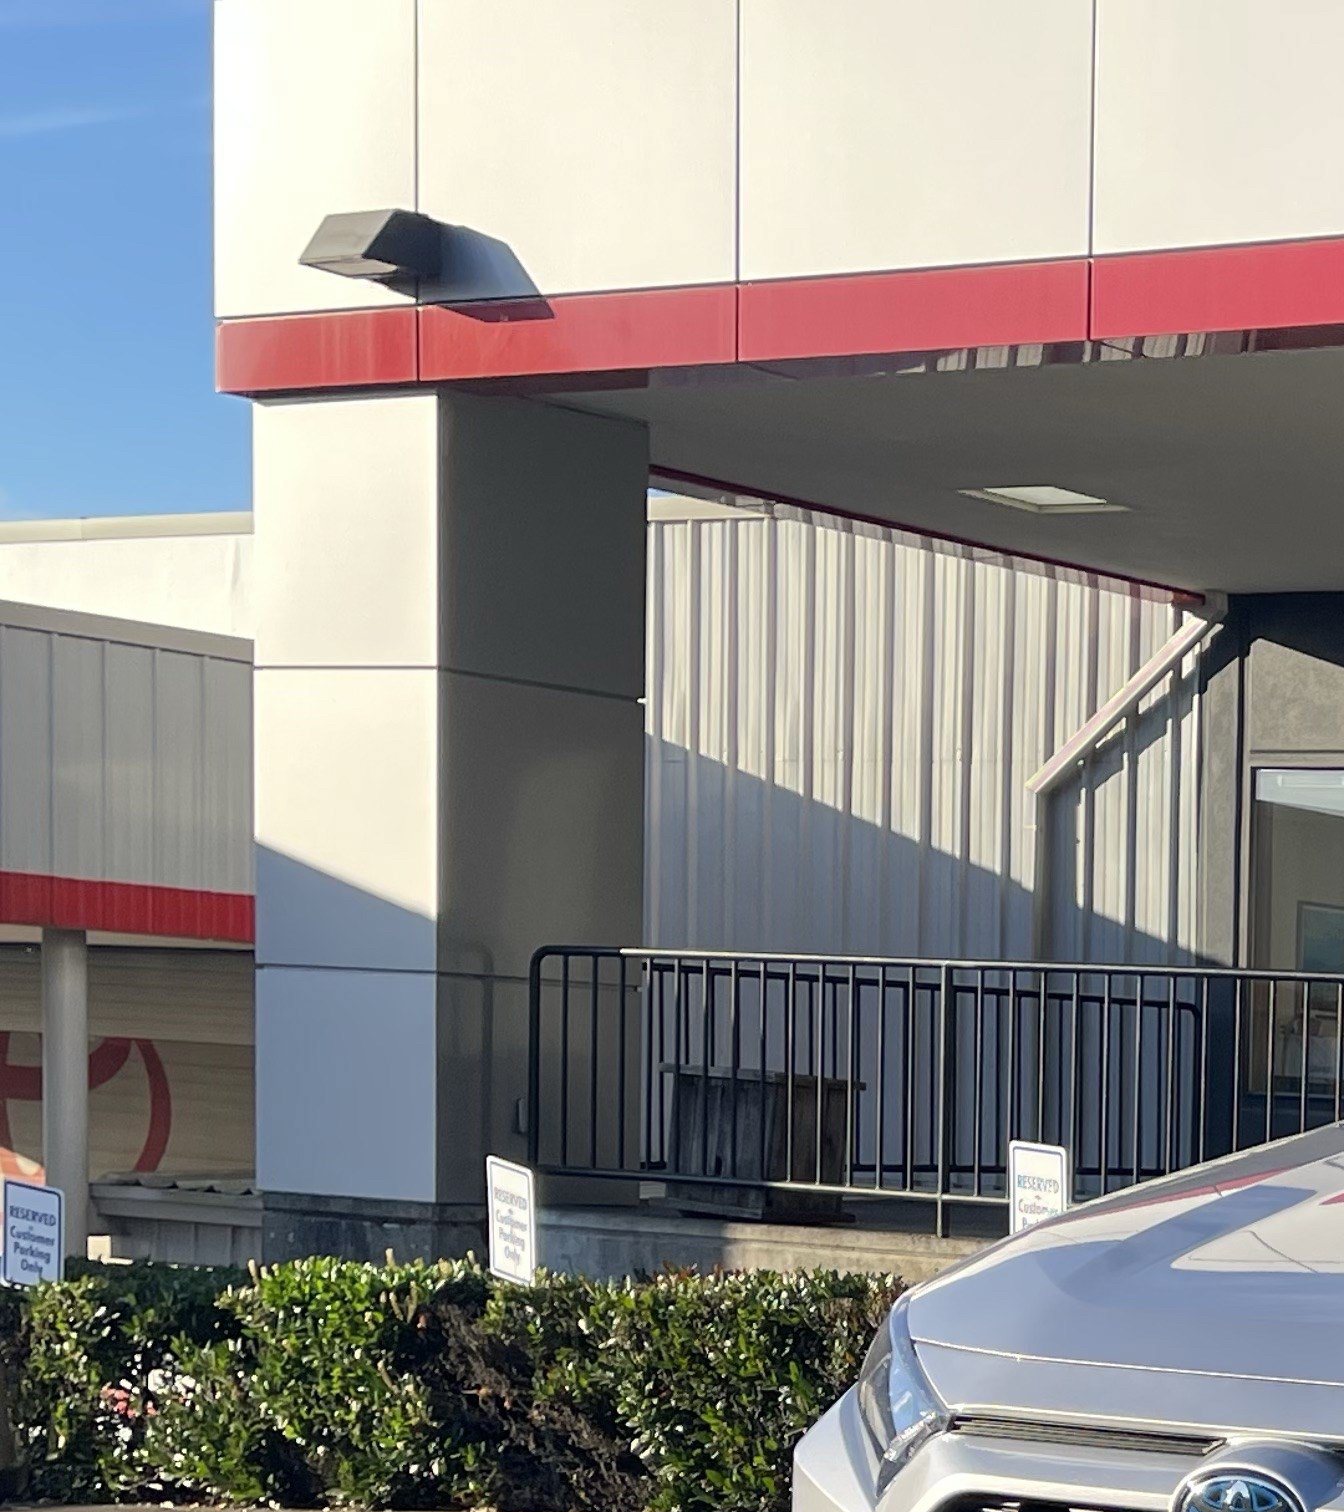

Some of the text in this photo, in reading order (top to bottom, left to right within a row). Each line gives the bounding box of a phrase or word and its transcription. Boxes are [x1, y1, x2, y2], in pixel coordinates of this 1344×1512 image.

[1018, 1174, 1059, 1194] RESERVED
[9, 1205, 56, 1226] RESERVED
[9, 1225, 56, 1246] Customer
[13, 1241, 51, 1264] Parking
[20, 1258, 43, 1278] Only
